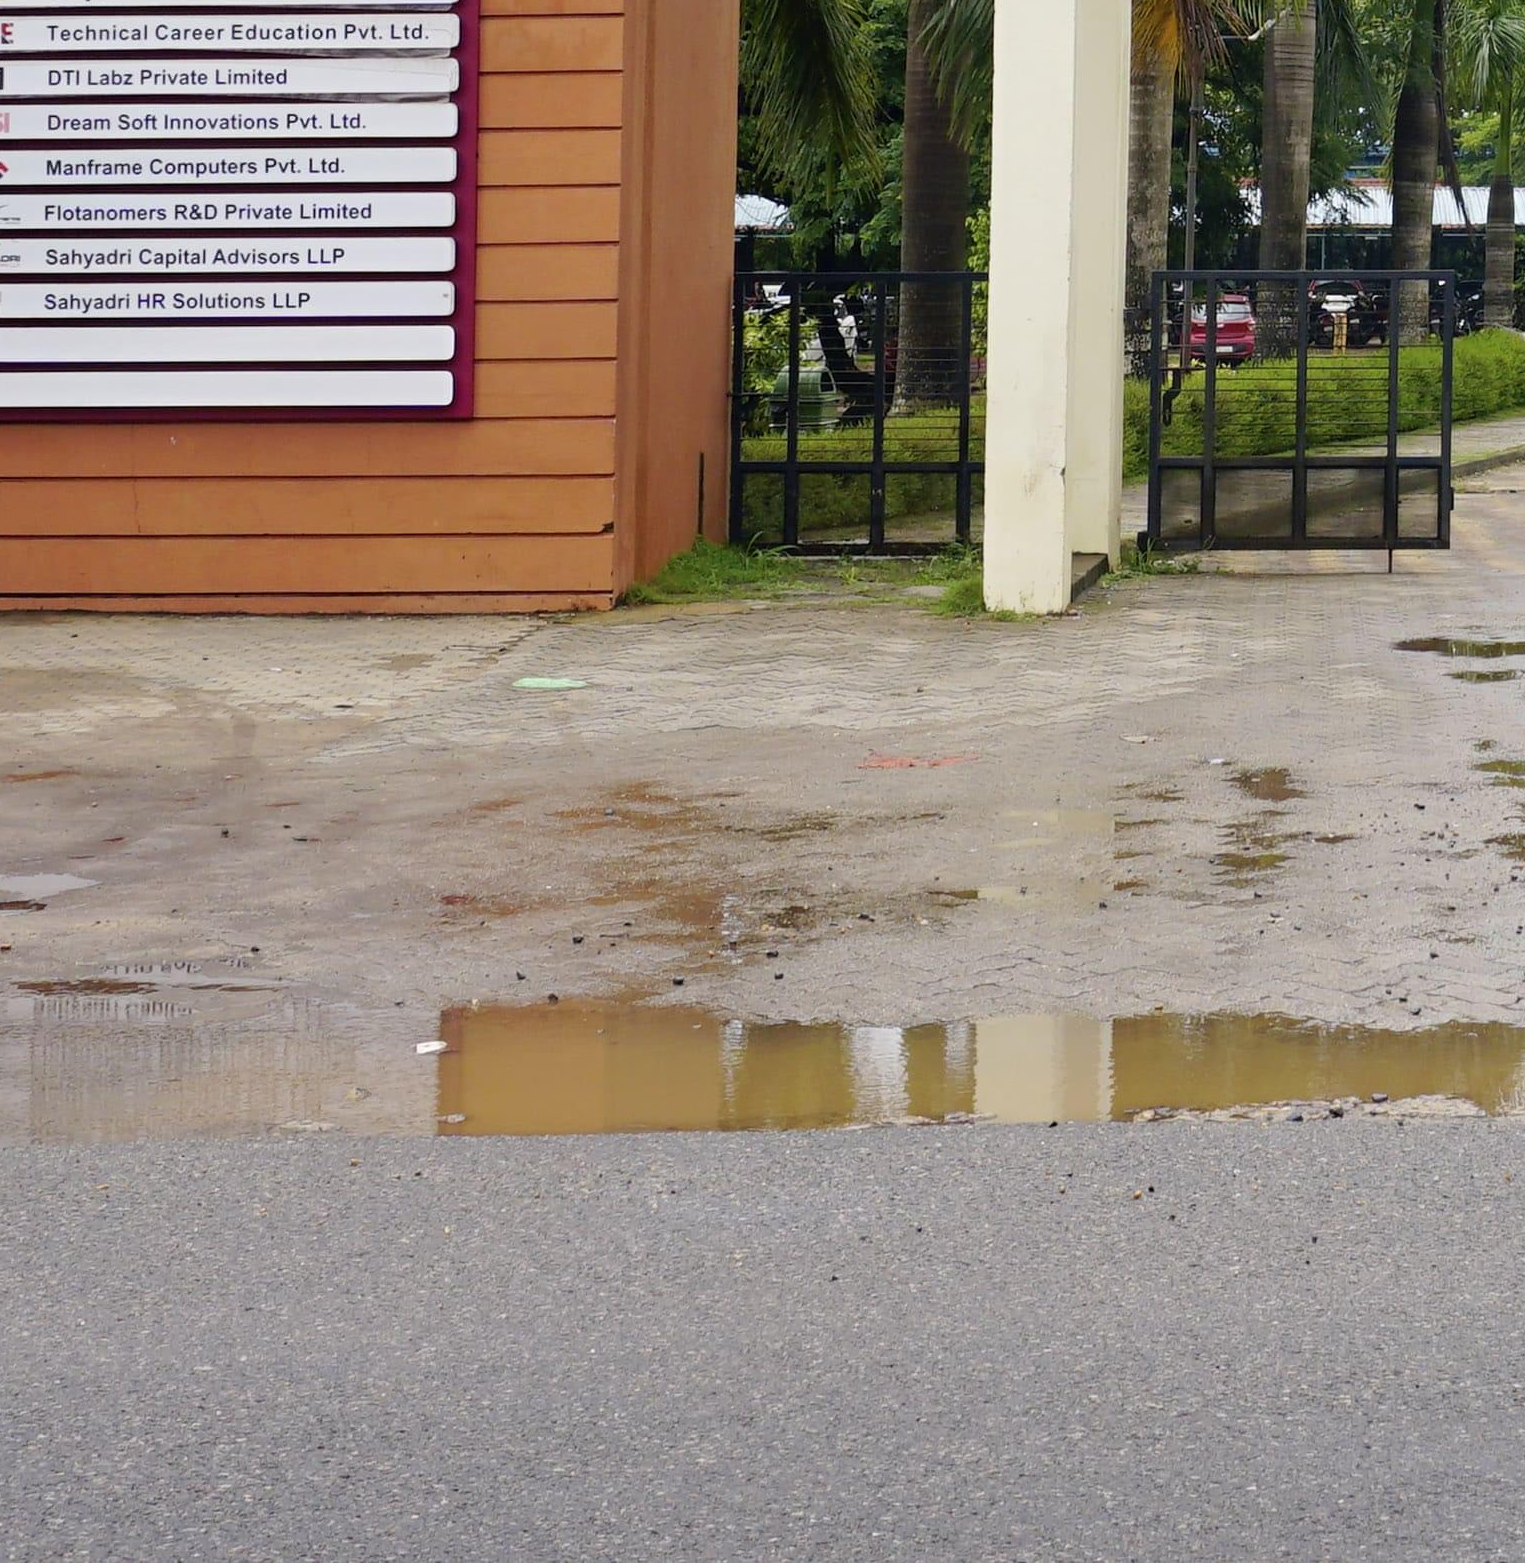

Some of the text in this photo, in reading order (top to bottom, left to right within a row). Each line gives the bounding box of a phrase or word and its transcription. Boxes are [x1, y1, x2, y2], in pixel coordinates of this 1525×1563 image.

[46, 23, 429, 42] Technical Career Education Pvt. Ltd.
[48, 68, 288, 86] DTI Labz Private Limited
[47, 113, 366, 131] Dream Soft Innovations Pvt. Ltd.
[46, 157, 345, 178] Manframe Computers Pvt. Ltd.
[44, 203, 372, 221] Flotanomers R&D Private Limited
[45, 248, 345, 270] Sahyadri Capital Advisors LLP
[44, 292, 311, 314] Sahyadri HR Solutions LLP
